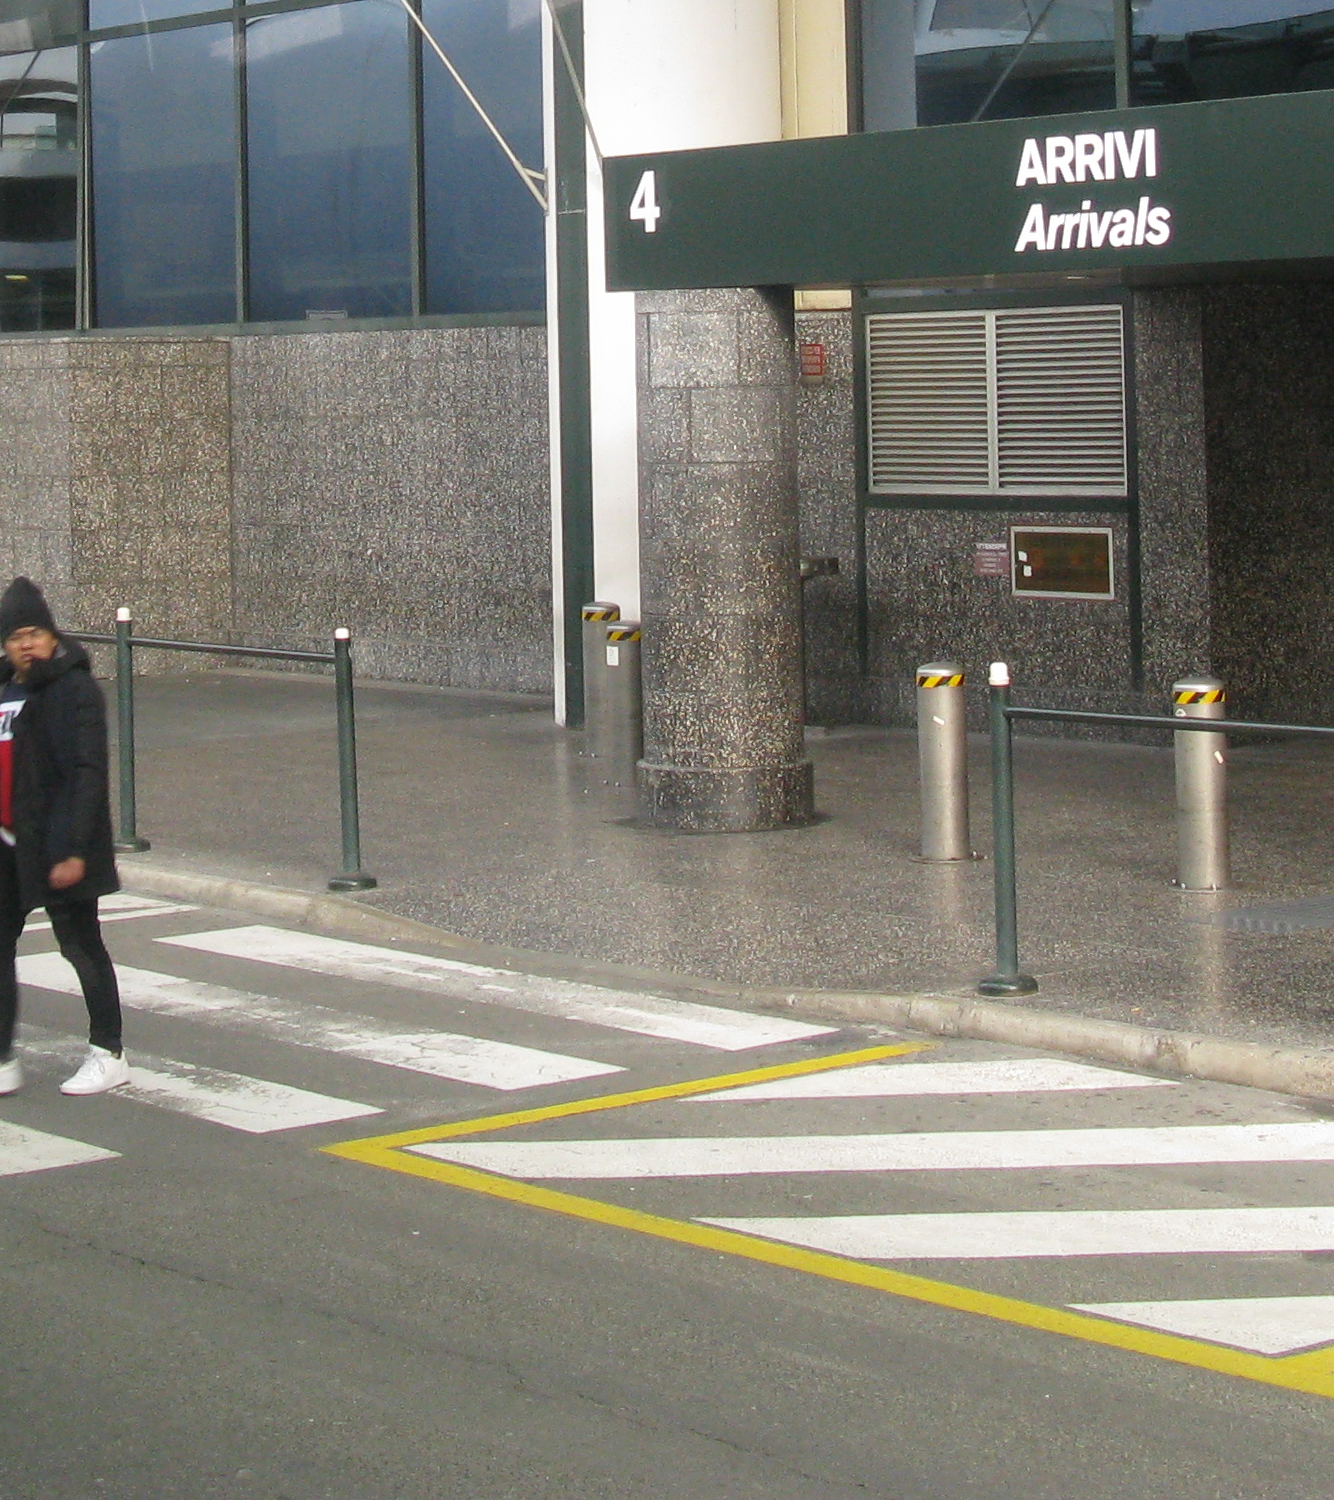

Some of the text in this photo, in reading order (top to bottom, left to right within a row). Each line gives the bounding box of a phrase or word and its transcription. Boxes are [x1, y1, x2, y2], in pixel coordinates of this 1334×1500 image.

[1015, 128, 1157, 187] ARRIVI
[629, 170, 661, 233] 4
[1014, 196, 1171, 252] Arrivals
